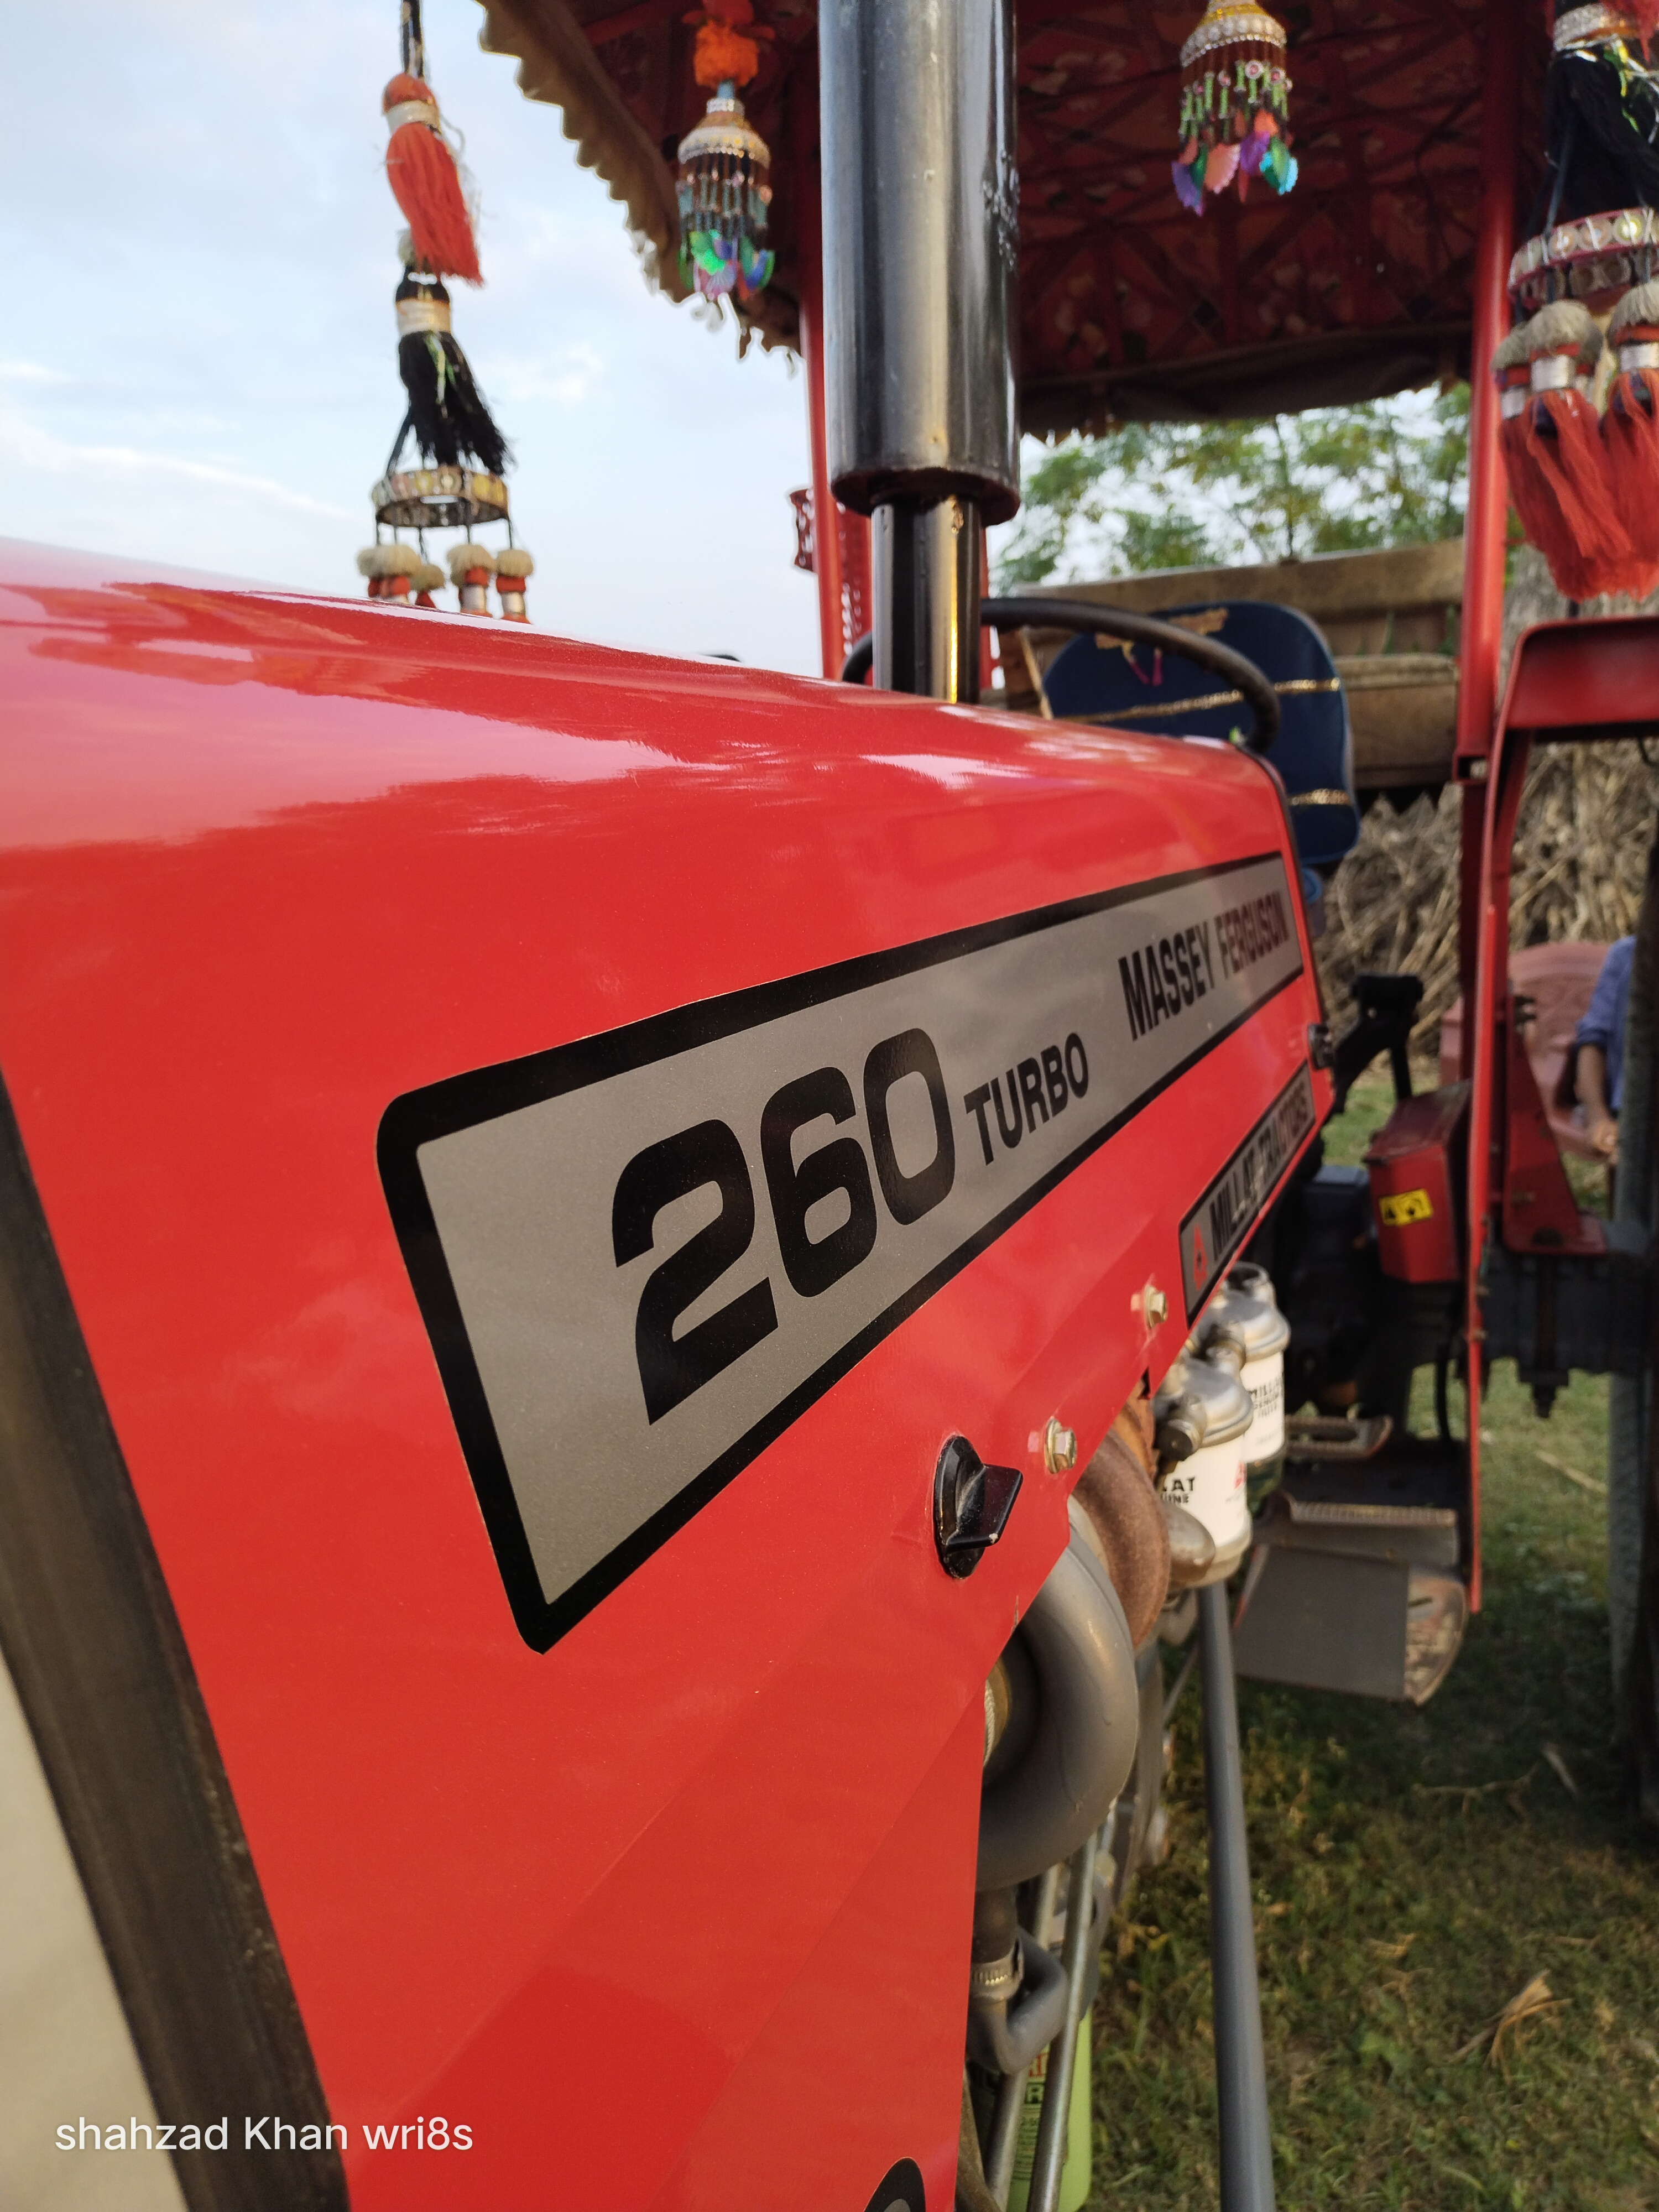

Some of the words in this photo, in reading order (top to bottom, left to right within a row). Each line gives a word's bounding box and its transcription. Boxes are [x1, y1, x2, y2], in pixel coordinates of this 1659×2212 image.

[1118, 920, 1214, 1041] MASSEY
[1214, 891, 1289, 979] FERGUSON
[612, 1028, 955, 1426] 260
[963, 1032, 1088, 1166] TURBO
